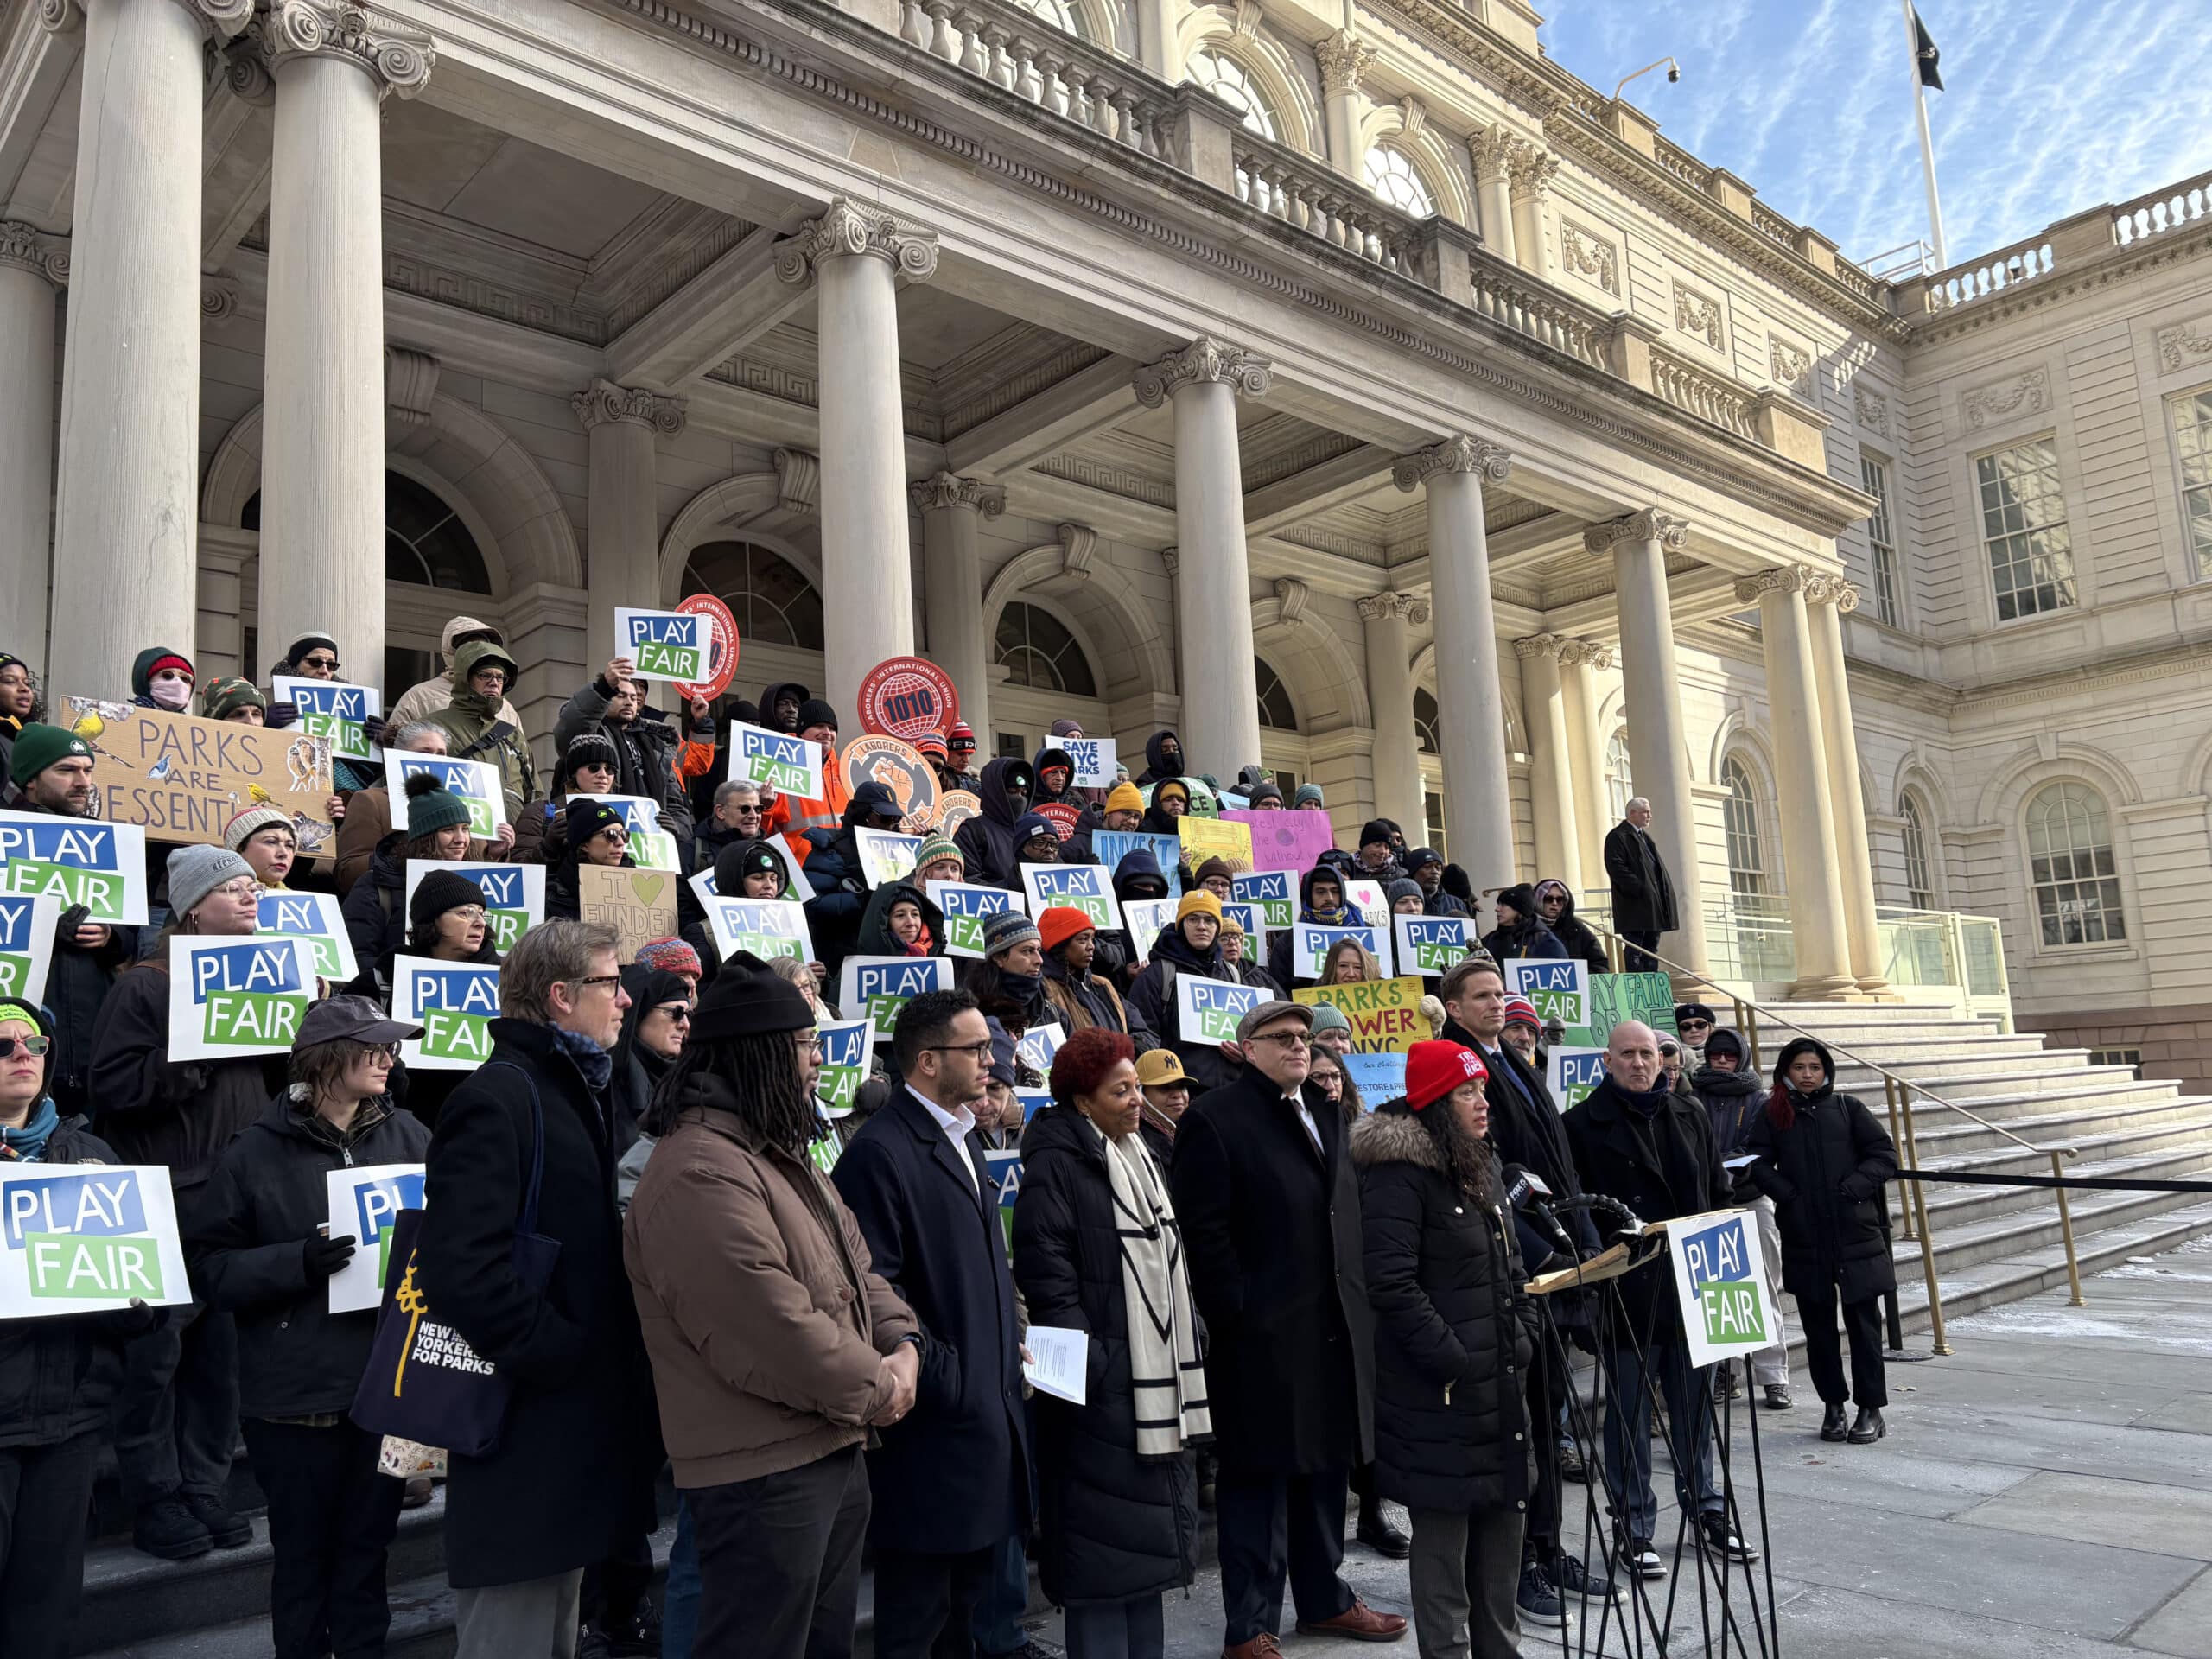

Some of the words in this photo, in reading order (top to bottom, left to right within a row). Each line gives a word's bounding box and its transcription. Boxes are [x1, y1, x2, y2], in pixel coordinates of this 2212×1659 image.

[632, 620, 693, 644] PLAY
[696, 602, 734, 644] INTERNATIONAL
[724, 646, 734, 676] UNION
[640, 645, 693, 676] FAIR
[877, 663, 939, 682] INTERNATIONAL
[939, 681, 952, 708] UNION
[295, 691, 360, 716] PLAY
[884, 690, 934, 723] 1010
[139, 719, 263, 775] PARKS
[308, 717, 365, 753] FAIR
[746, 734, 801, 763] PLAY
[859, 741, 907, 757] LABORERS
[1063, 741, 1098, 753] SAVE
[164, 772, 223, 791] ARE
[753, 757, 806, 791] FAIR
[625, 804, 651, 830] AY
[940, 799, 972, 817] LABORERS
[0, 828, 106, 864] PLAY
[624, 835, 664, 865] AIR
[14, 864, 115, 914] FAIR
[480, 873, 517, 904] AY
[601, 871, 626, 905] I
[1038, 871, 1090, 896] PLAY
[1234, 876, 1282, 902] PLAY
[583, 903, 678, 938] FUNDED
[726, 908, 782, 934] PLAY
[945, 893, 1005, 918] PLAY
[1227, 909, 1248, 932] AY
[956, 918, 984, 949] FA
[1410, 924, 1459, 944] PLAY
[198, 947, 289, 996] PLAY
[861, 965, 932, 998] PLAY
[1521, 965, 1573, 992] PLAY
[1194, 987, 1251, 1013] PLAY
[1317, 982, 1402, 1013] PARKS
[1590, 974, 1618, 1009] AY
[1624, 972, 1674, 1009] FAIR
[209, 997, 296, 1039] FAIR
[870, 999, 902, 1028] FA
[1532, 994, 1578, 1020] FAIR
[427, 1015, 494, 1056] FAI
[1205, 1011, 1236, 1036] FA
[827, 1028, 865, 1065] LAY
[1021, 1034, 1048, 1065] AY
[1563, 1055, 1605, 1086] PLA
[10, 1179, 130, 1240] PLAY
[34, 1242, 156, 1291] FAIR
[1687, 1226, 1740, 1291] PLAY
[1703, 1290, 1762, 1336] FAIR
[419, 1321, 453, 1340] NEW
[412, 1348, 441, 1366] FOR
[442, 1354, 496, 1376] PARKS
[417, 1333, 481, 1360] YORKER
